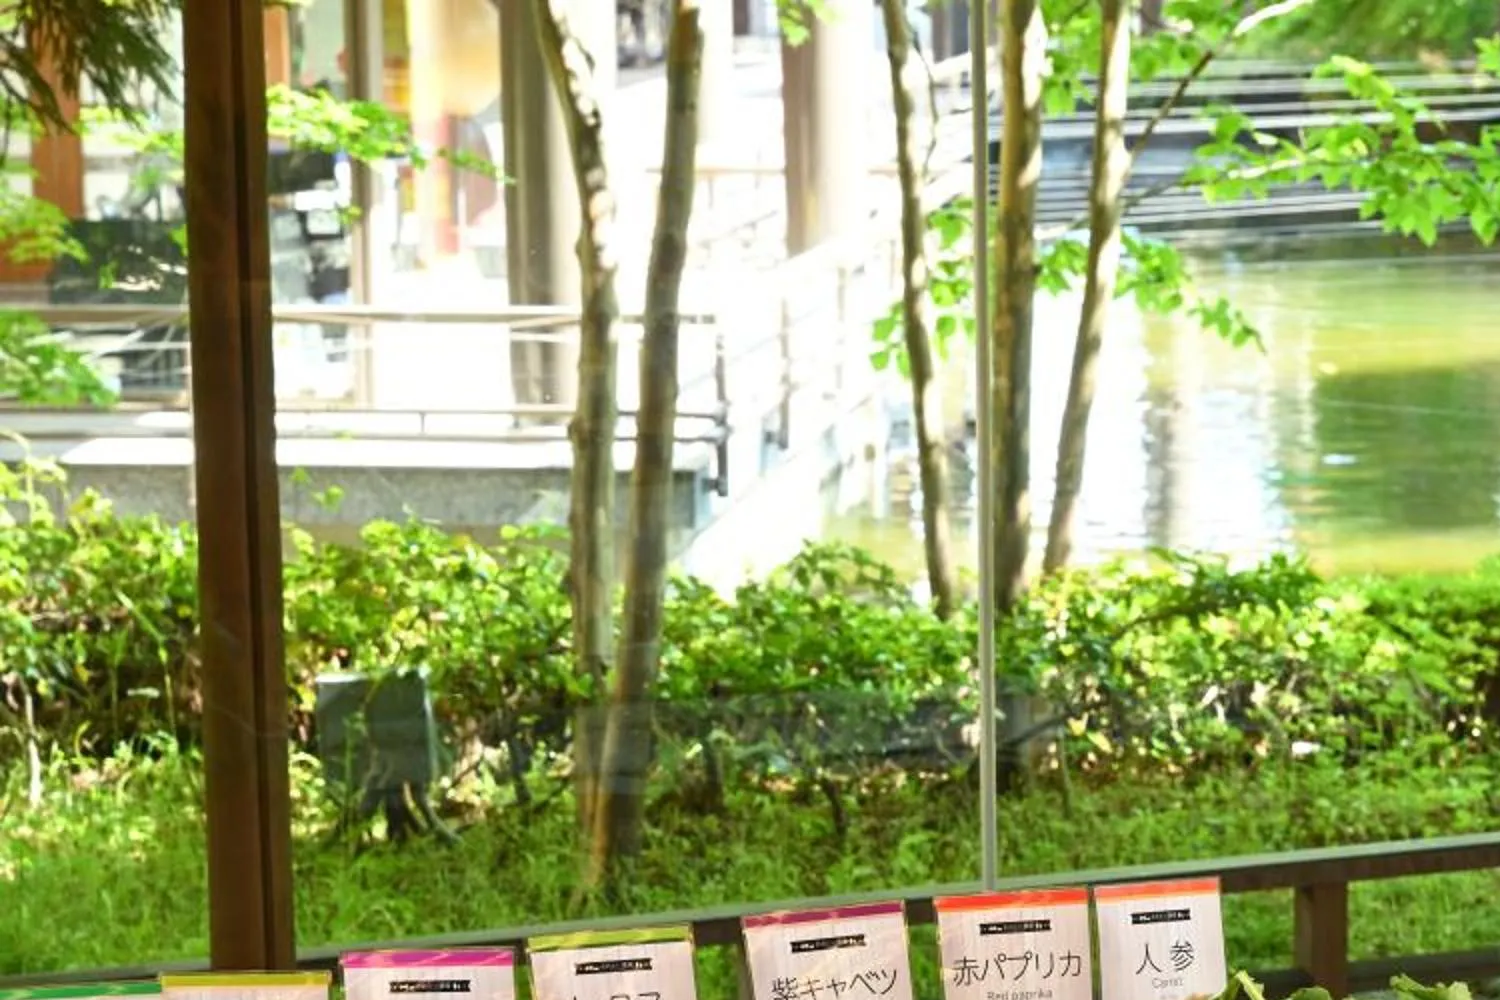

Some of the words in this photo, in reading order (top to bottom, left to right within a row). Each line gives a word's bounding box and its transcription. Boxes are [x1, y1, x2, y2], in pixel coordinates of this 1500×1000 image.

[953, 950, 1083, 987] 赤パプリカ
[1135, 940, 1197, 976] 人参
